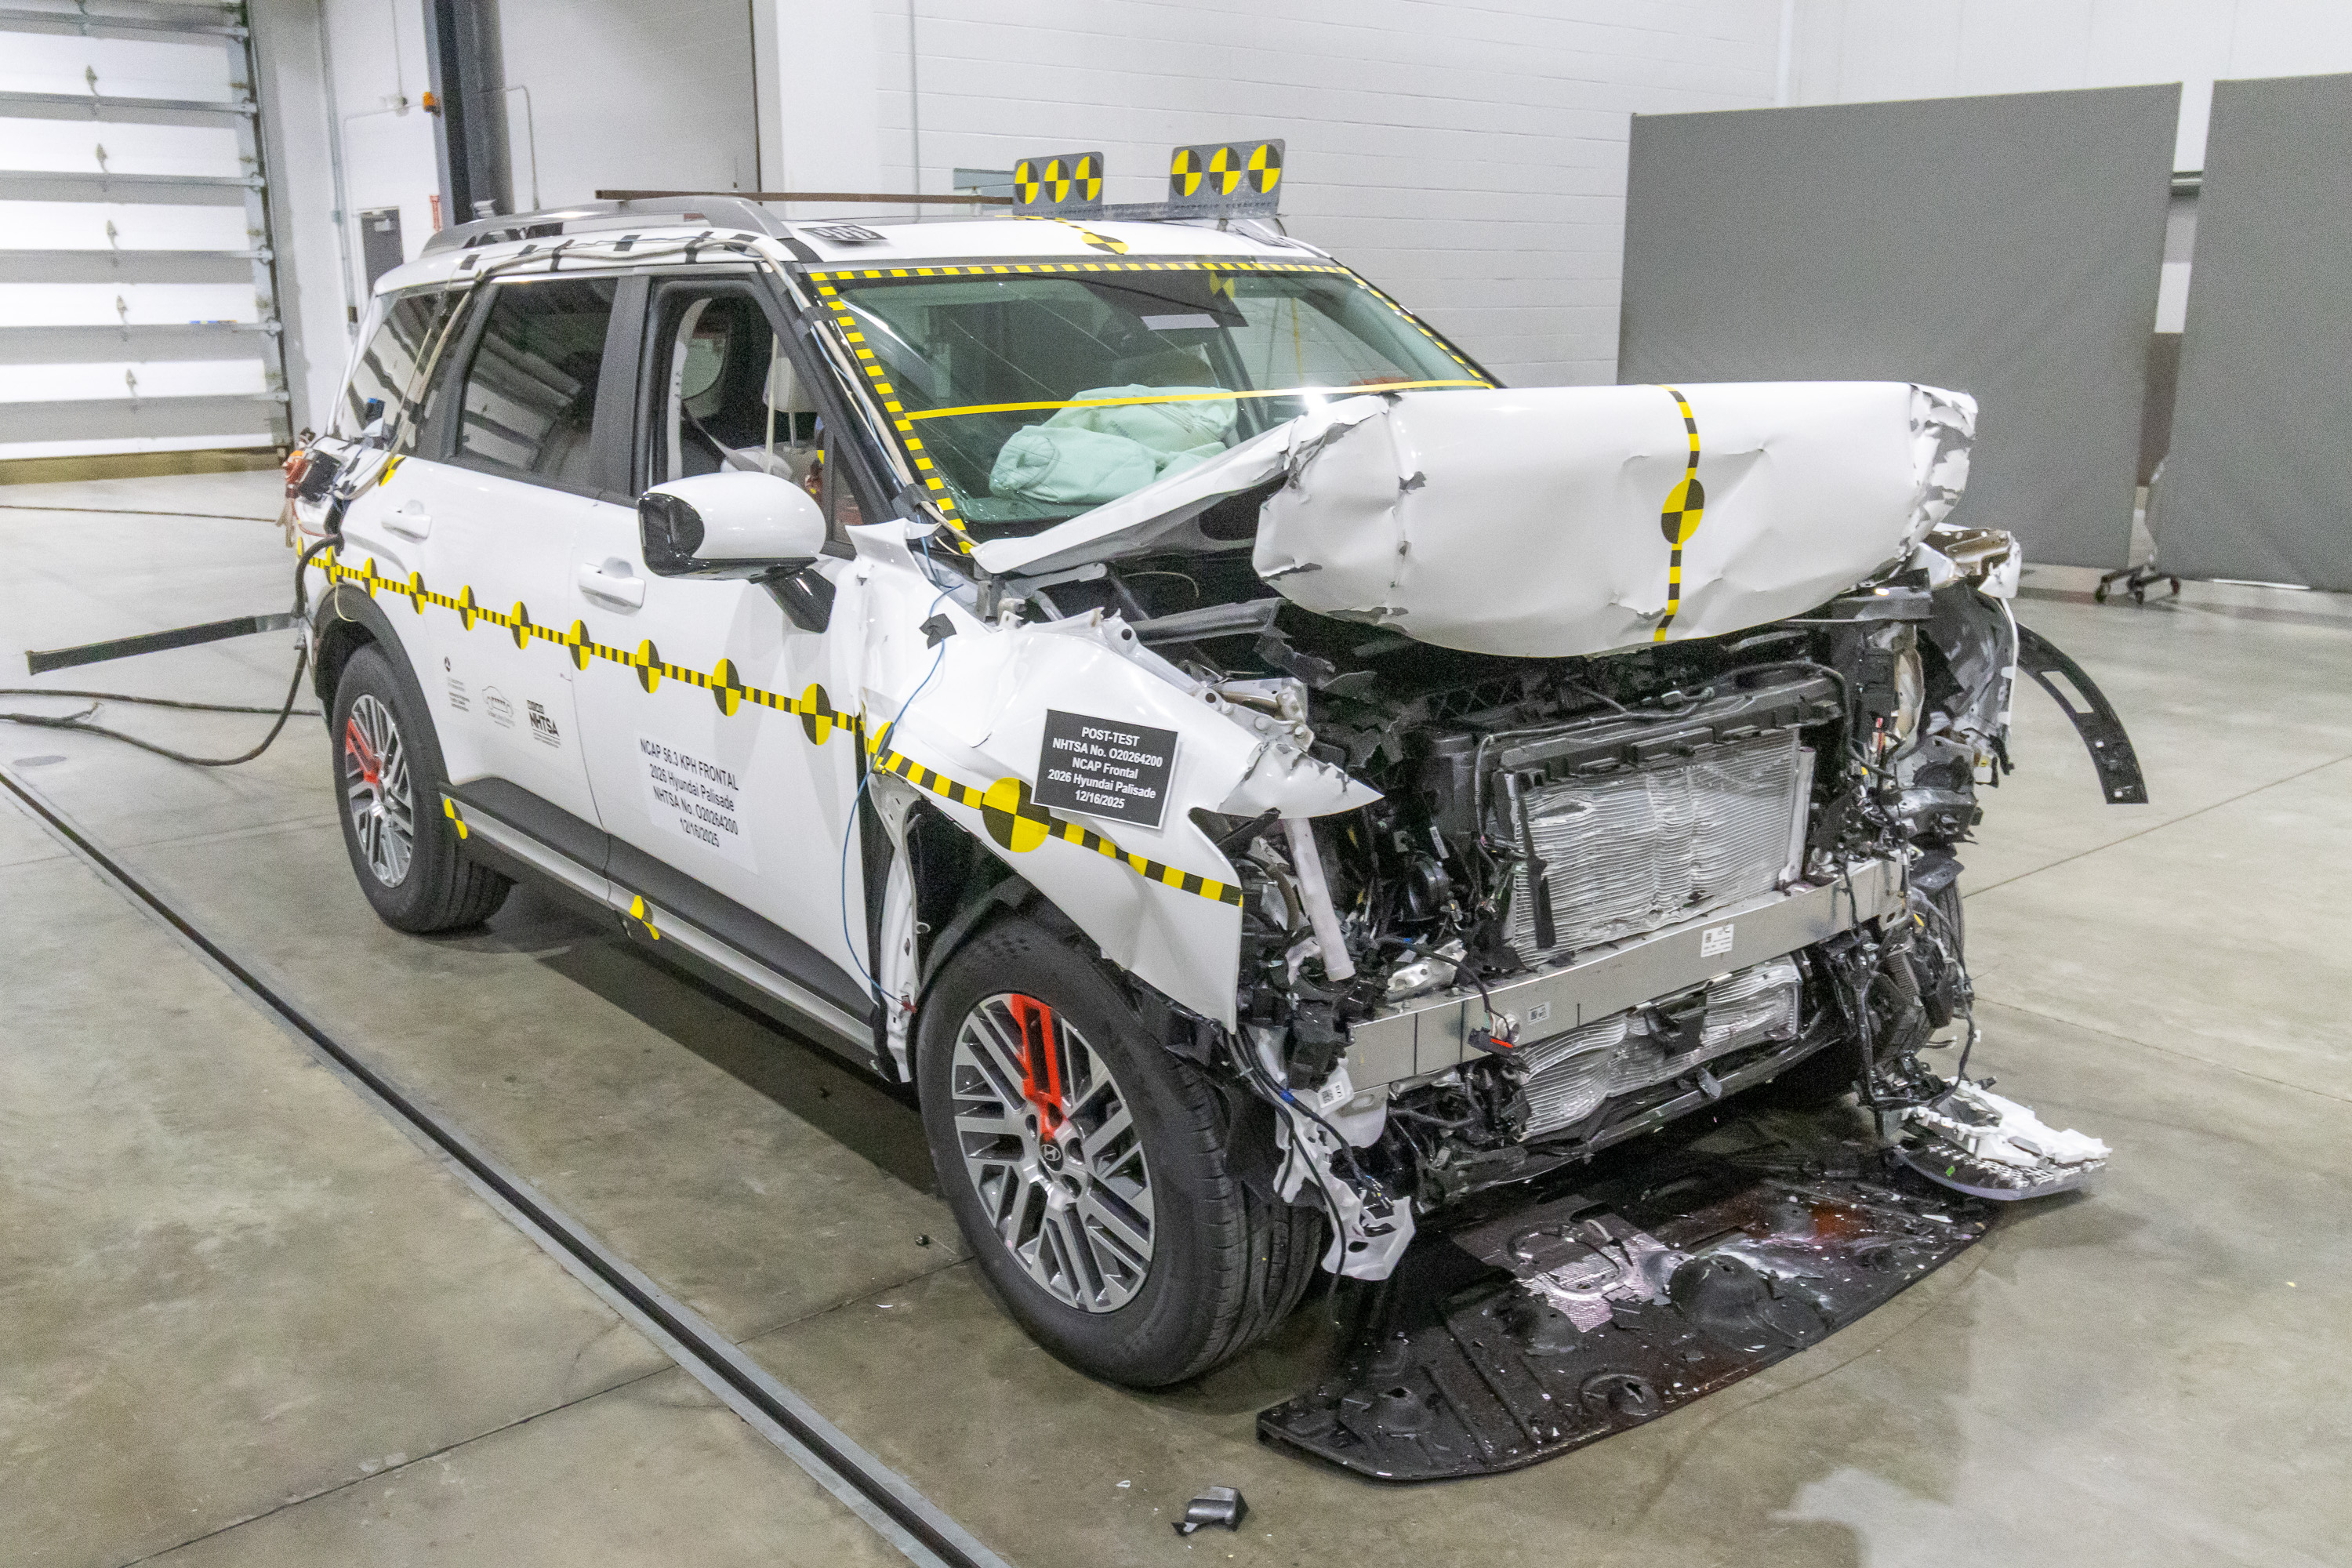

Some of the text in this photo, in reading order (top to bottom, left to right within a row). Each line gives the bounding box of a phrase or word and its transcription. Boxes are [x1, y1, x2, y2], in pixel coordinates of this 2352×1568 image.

[529, 713, 559, 737] NHTSA
[1082, 727, 1140, 746] POST-TEST
[1052, 738, 1087, 753] NHTSA
[1090, 746, 1106, 757] No.
[640, 739, 739, 791] NCAP 56.3 KPH FRONTAL
[1072, 757, 1138, 779] NCAP Frontal
[649, 764, 735, 811] 2026 Hyundai Palisade
[1047, 769, 1156, 799] 2026 Hyundai Palisade
[652, 786, 681, 810] NHTSA
[681, 797, 695, 816] No.
[1075, 790, 1125, 809] 12/16/2025
[680, 818, 720, 848] 12/16/2025
